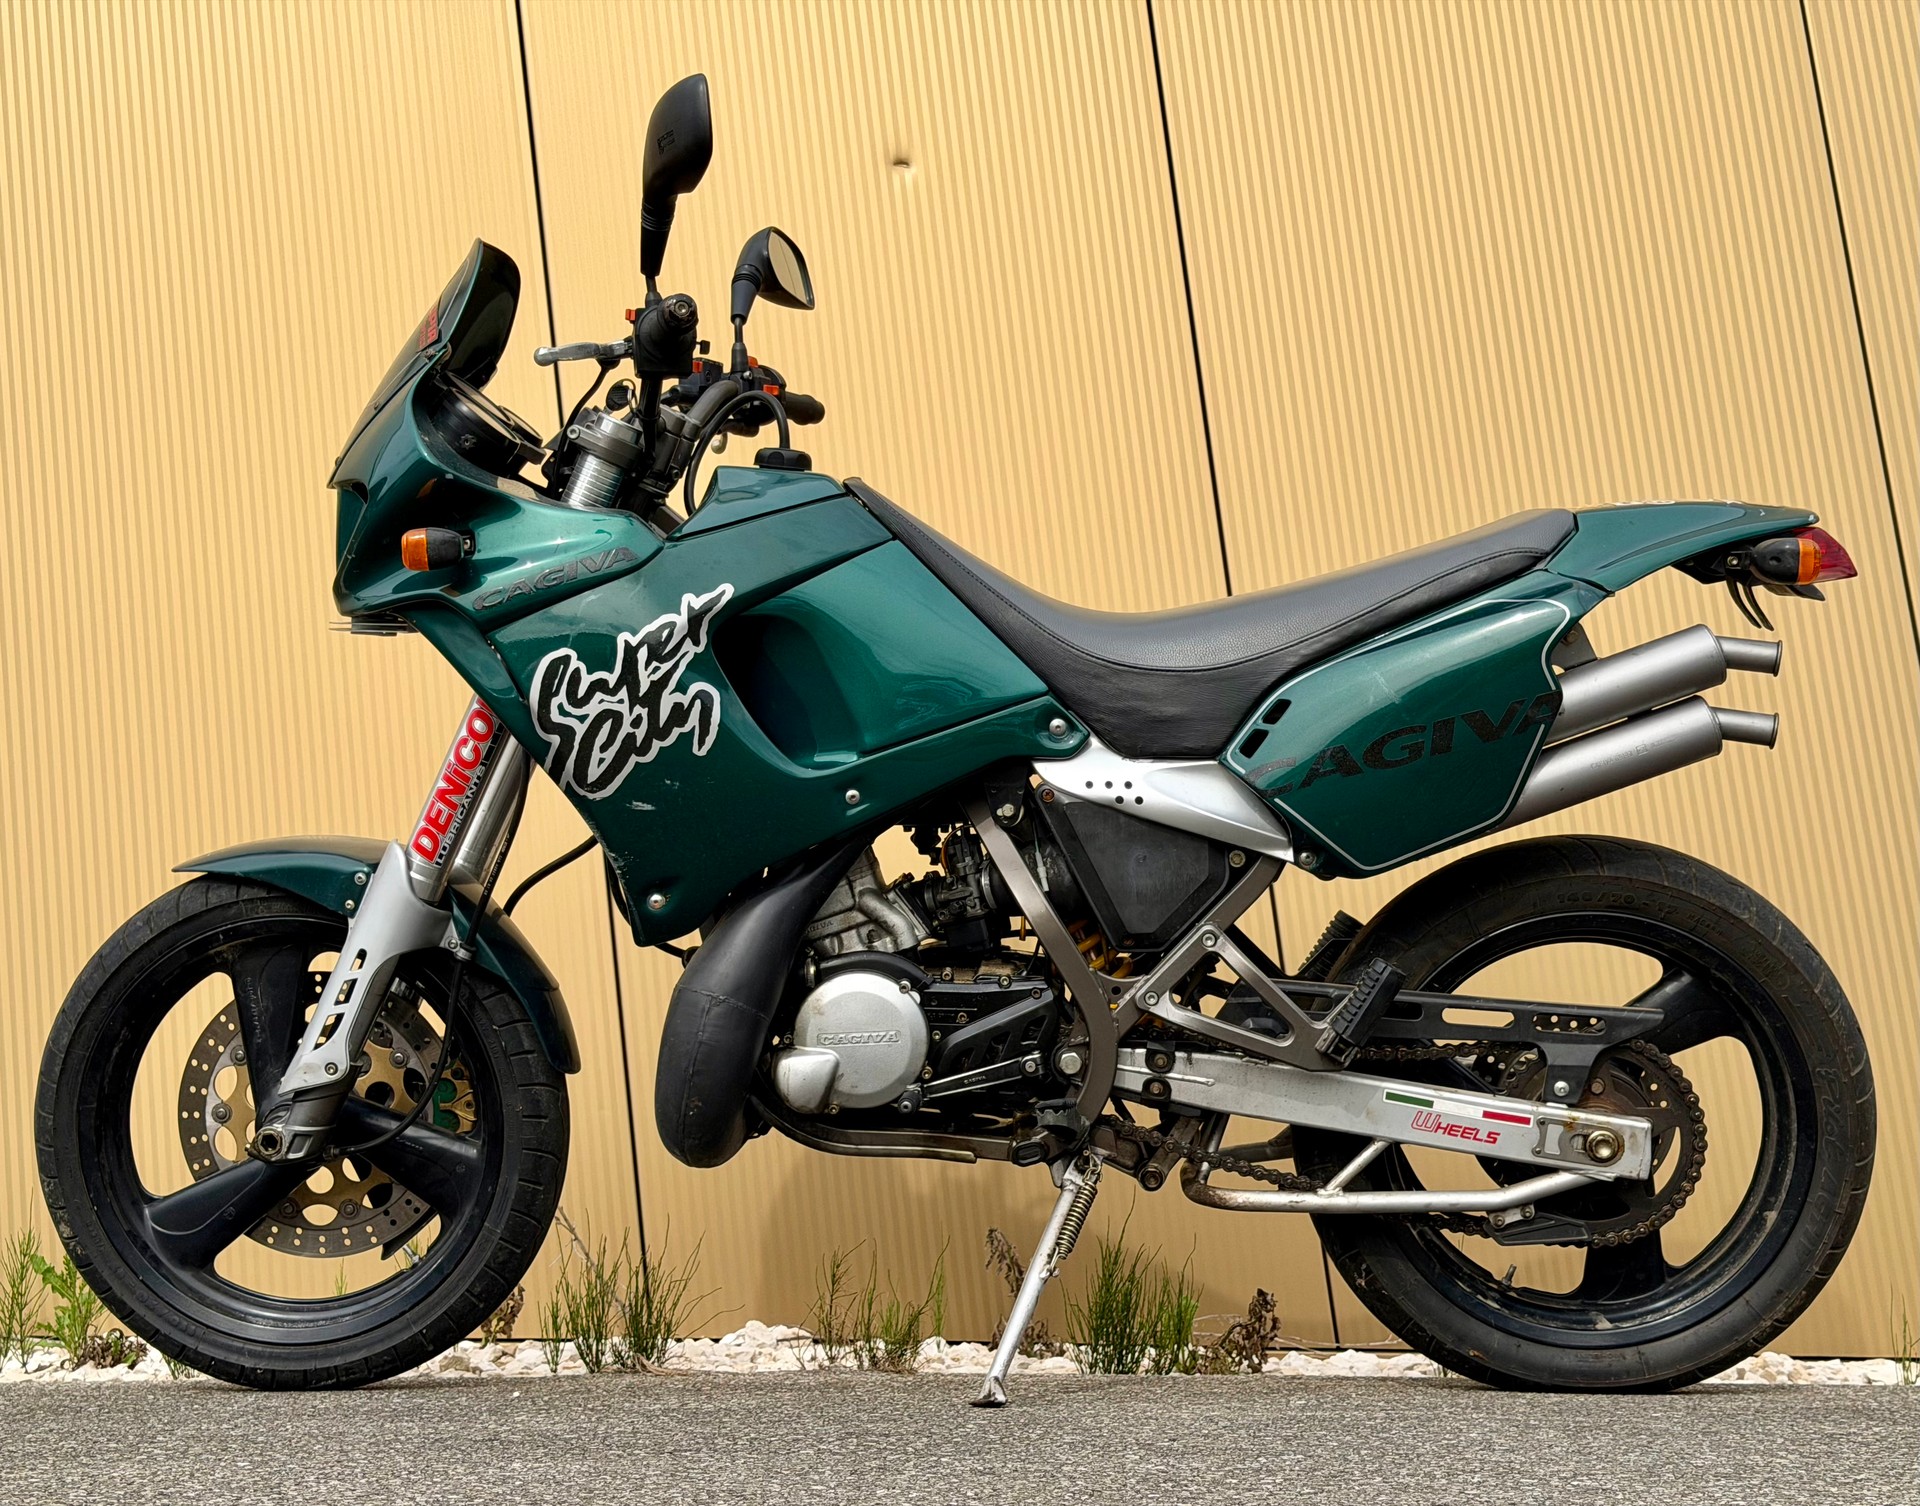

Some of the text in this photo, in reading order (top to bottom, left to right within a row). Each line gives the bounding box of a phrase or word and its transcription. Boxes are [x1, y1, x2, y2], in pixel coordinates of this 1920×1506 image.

[472, 546, 638, 611] CAGIVA
[533, 586, 730, 788] Super
[570, 650, 717, 796] City
[1242, 690, 1564, 799] CAGIVA
[436, 763, 487, 868] LUBRICANTS
[819, 1031, 900, 1045] CAGIVA
